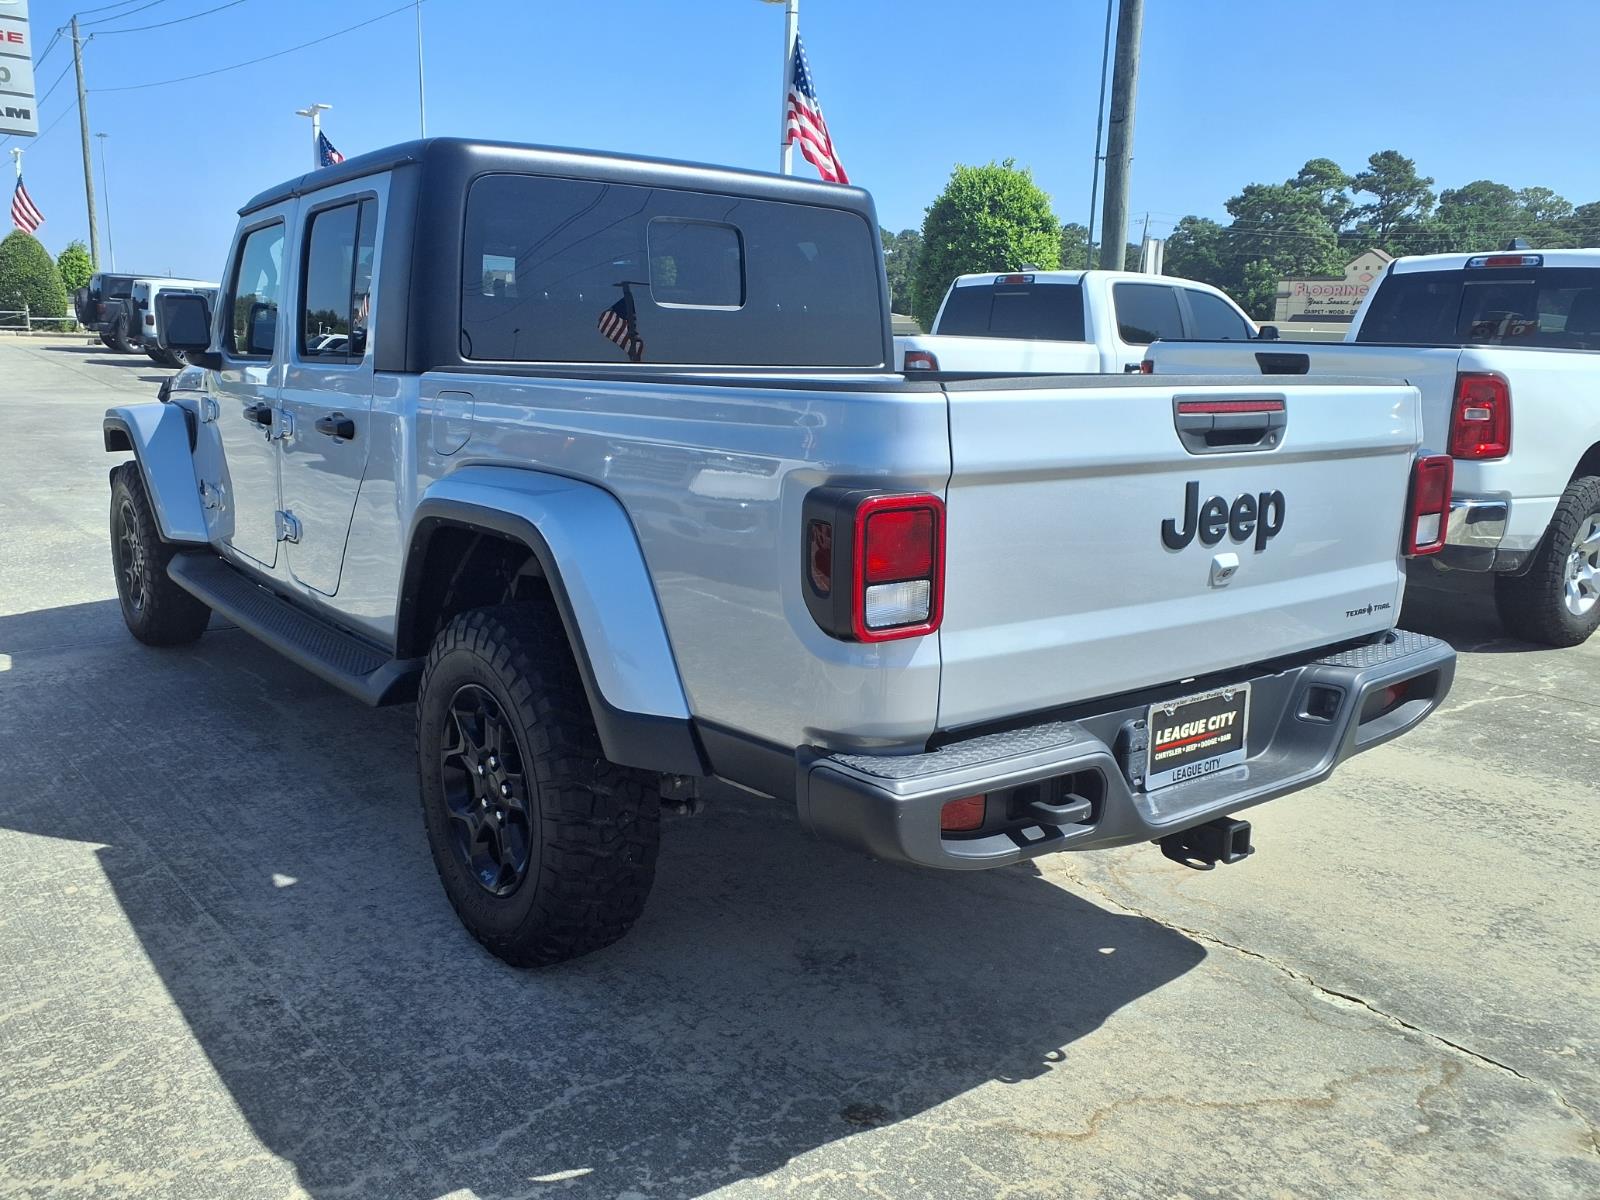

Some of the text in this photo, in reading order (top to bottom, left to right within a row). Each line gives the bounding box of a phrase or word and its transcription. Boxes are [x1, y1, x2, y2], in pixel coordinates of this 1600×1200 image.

[1161, 480, 1286, 552] Jeep
[1345, 602, 1391, 618] TEXAS TRAIL
[1156, 711, 1237, 744] LEAGUE CITY
[1155, 733, 1232, 760] CHRYSLER JEEP DODGE RAM
[1172, 758, 1221, 781] LEAGUE CITY
